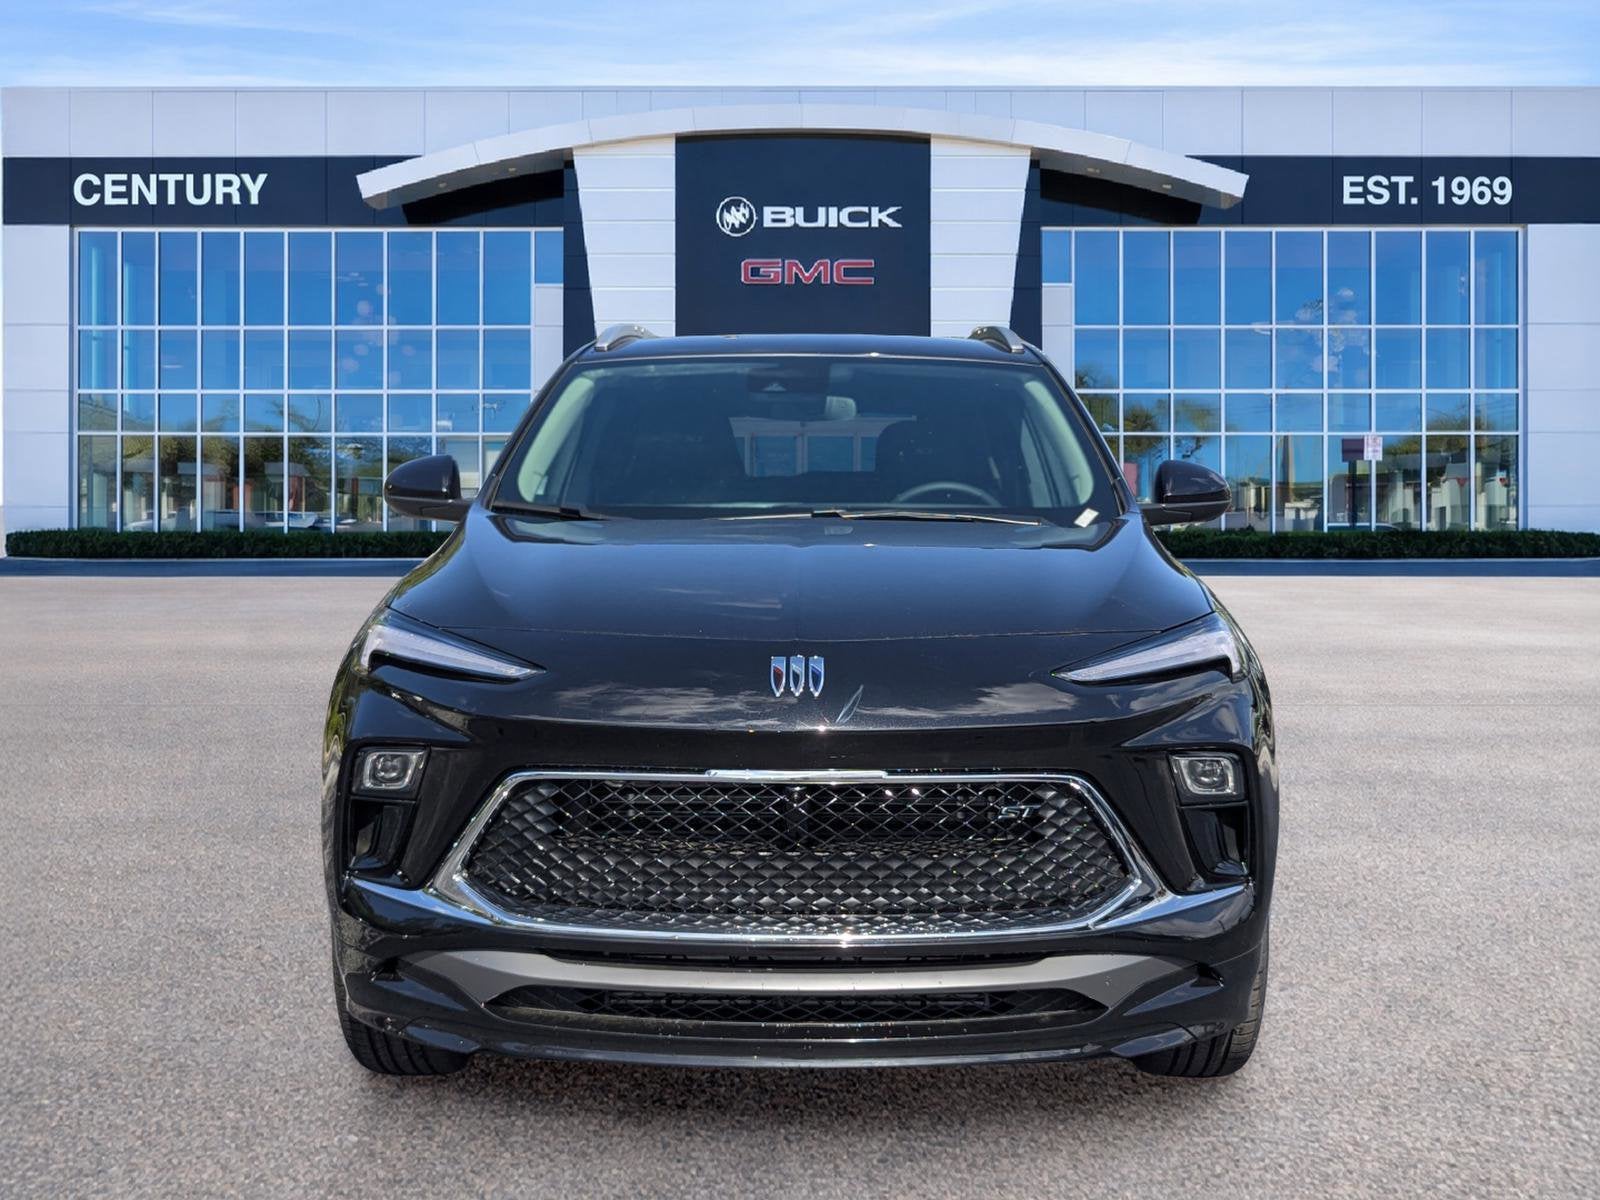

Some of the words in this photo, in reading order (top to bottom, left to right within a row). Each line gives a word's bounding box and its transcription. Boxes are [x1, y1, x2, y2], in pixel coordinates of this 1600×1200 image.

[73, 173, 268, 206] CENTURY
[1342, 175, 1418, 206] EST.
[1431, 175, 1513, 206] 1969
[763, 206, 902, 228] BUICK
[741, 258, 875, 285] GMC
